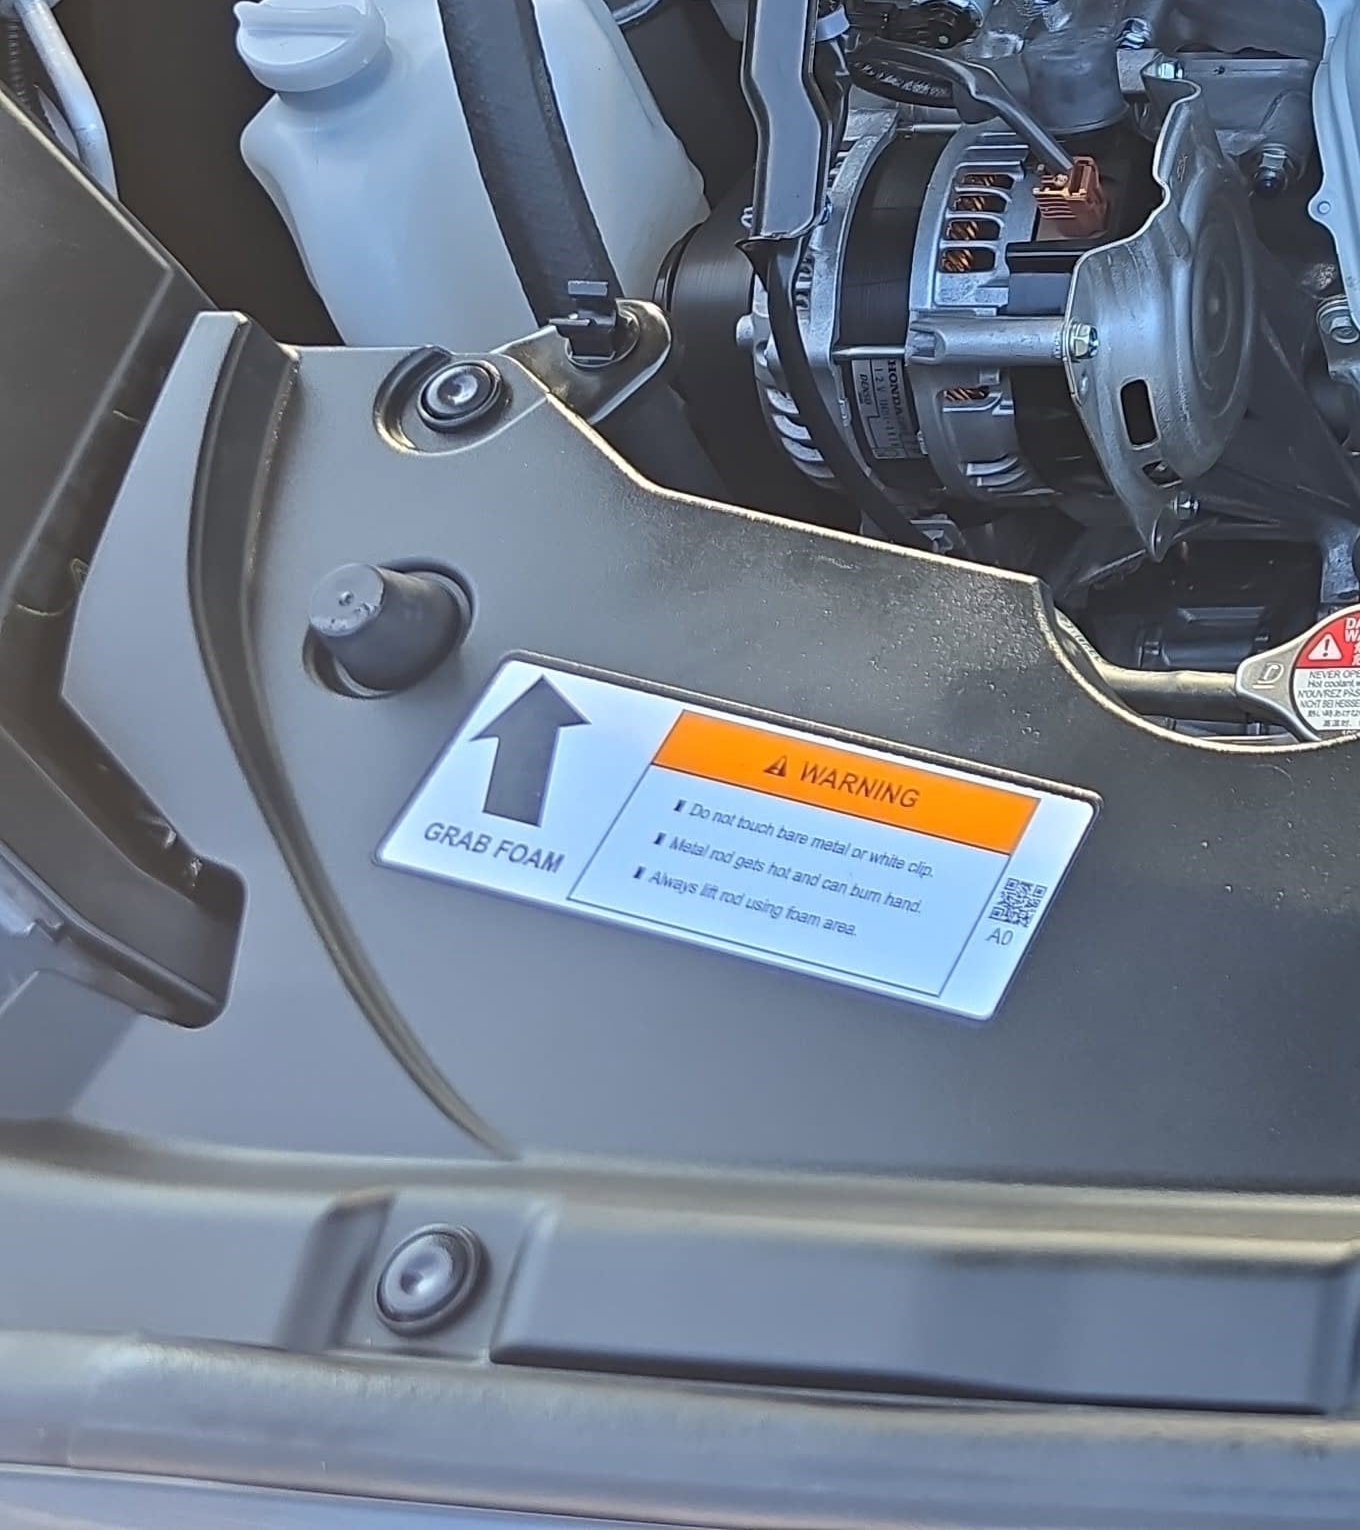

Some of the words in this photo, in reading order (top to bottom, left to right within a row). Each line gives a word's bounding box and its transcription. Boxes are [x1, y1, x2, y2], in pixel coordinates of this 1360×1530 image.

[1307, 680, 1323, 688] Hot
[1309, 671, 1341, 679] NEVER
[800, 761, 920, 808] WARNING
[424, 822, 493, 854] GRAB
[493, 839, 566, 874] FOAM
[689, 803, 711, 819] Do
[712, 812, 736, 826] not
[737, 815, 776, 837] touch
[776, 827, 808, 845] bare
[810, 836, 851, 857] metal
[851, 846, 868, 859] or
[869, 850, 906, 870] white
[907, 860, 934, 879] clip.
[669, 836, 710, 857] Metal
[710, 848, 737, 864] rod
[734, 855, 766, 873] gets
[767, 862, 793, 880] hot
[792, 870, 823, 887] and
[822, 878, 849, 895] can
[850, 883, 882, 904] burn
[883, 894, 922, 914] hand.
[648, 870, 699, 895] Always
[700, 882, 719, 901] lift
[719, 889, 747, 906] rod
[745, 898, 784, 920] using
[785, 905, 822, 926] foam
[822, 918, 858, 937] area.
